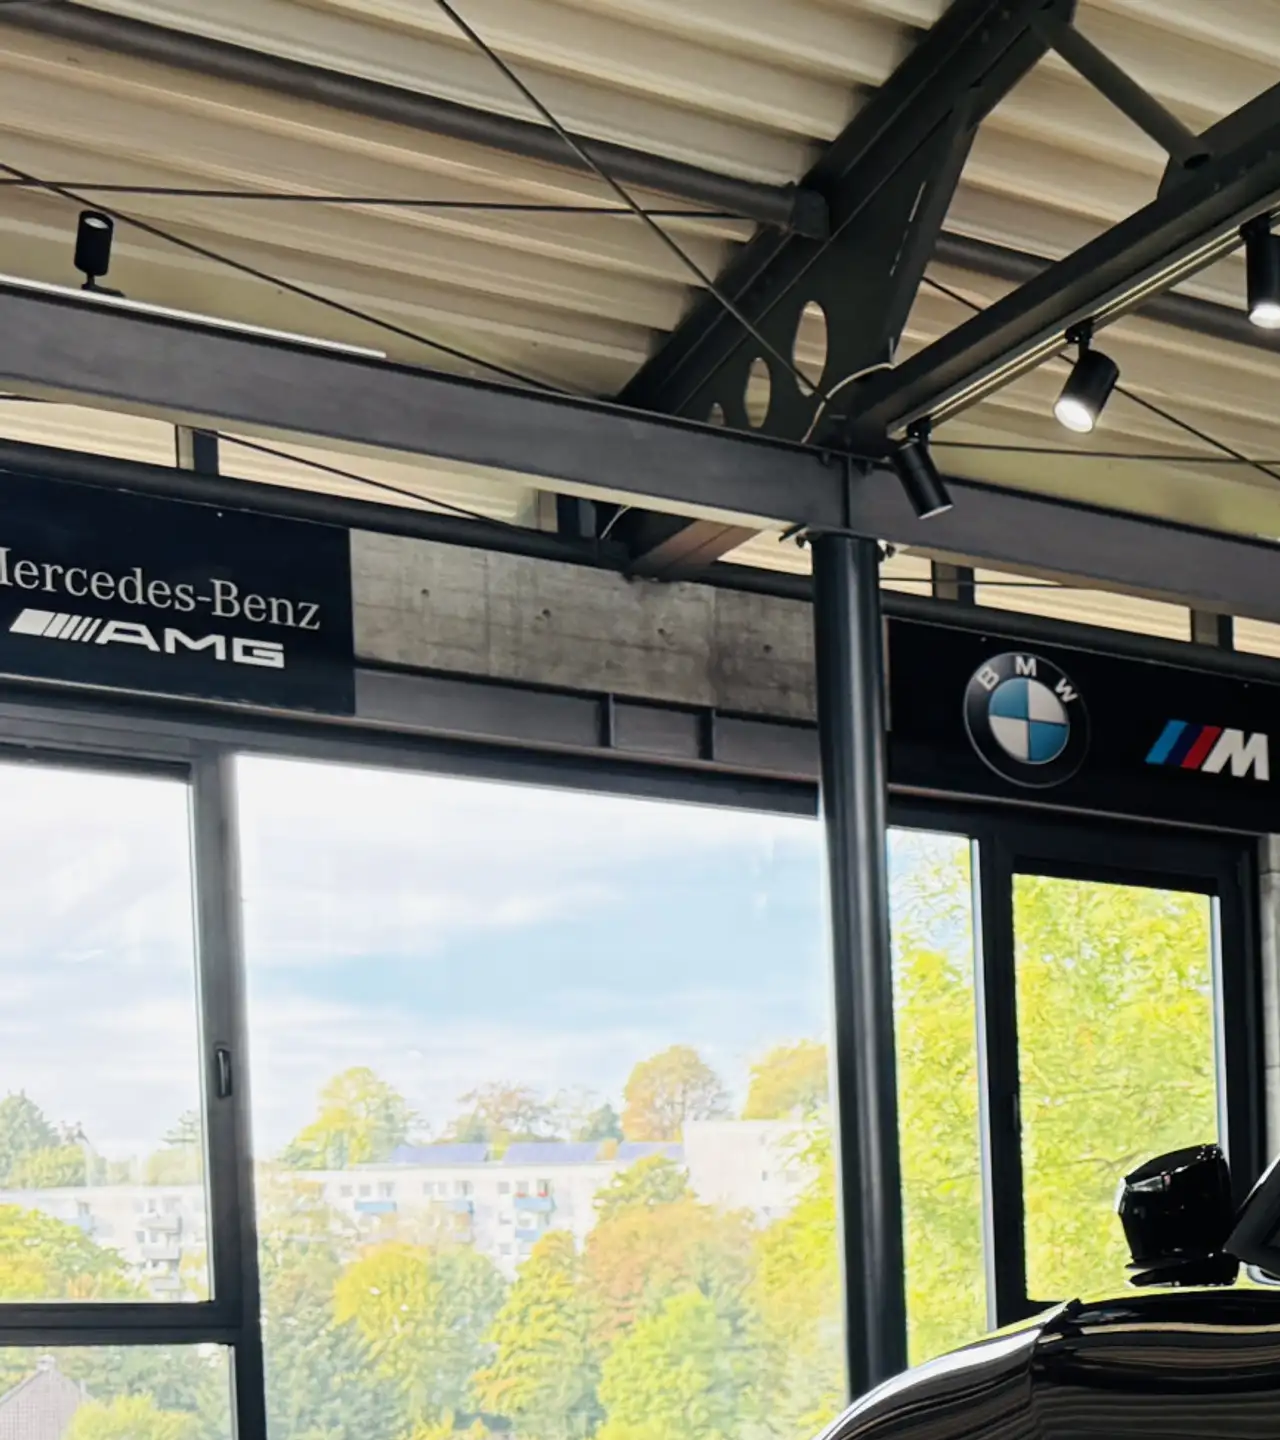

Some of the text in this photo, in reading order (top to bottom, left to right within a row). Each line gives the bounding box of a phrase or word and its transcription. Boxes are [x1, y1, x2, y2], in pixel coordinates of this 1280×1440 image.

[95, 620, 285, 668] AMG
[976, 655, 1078, 703] BMW
[1201, 728, 1270, 781] M
